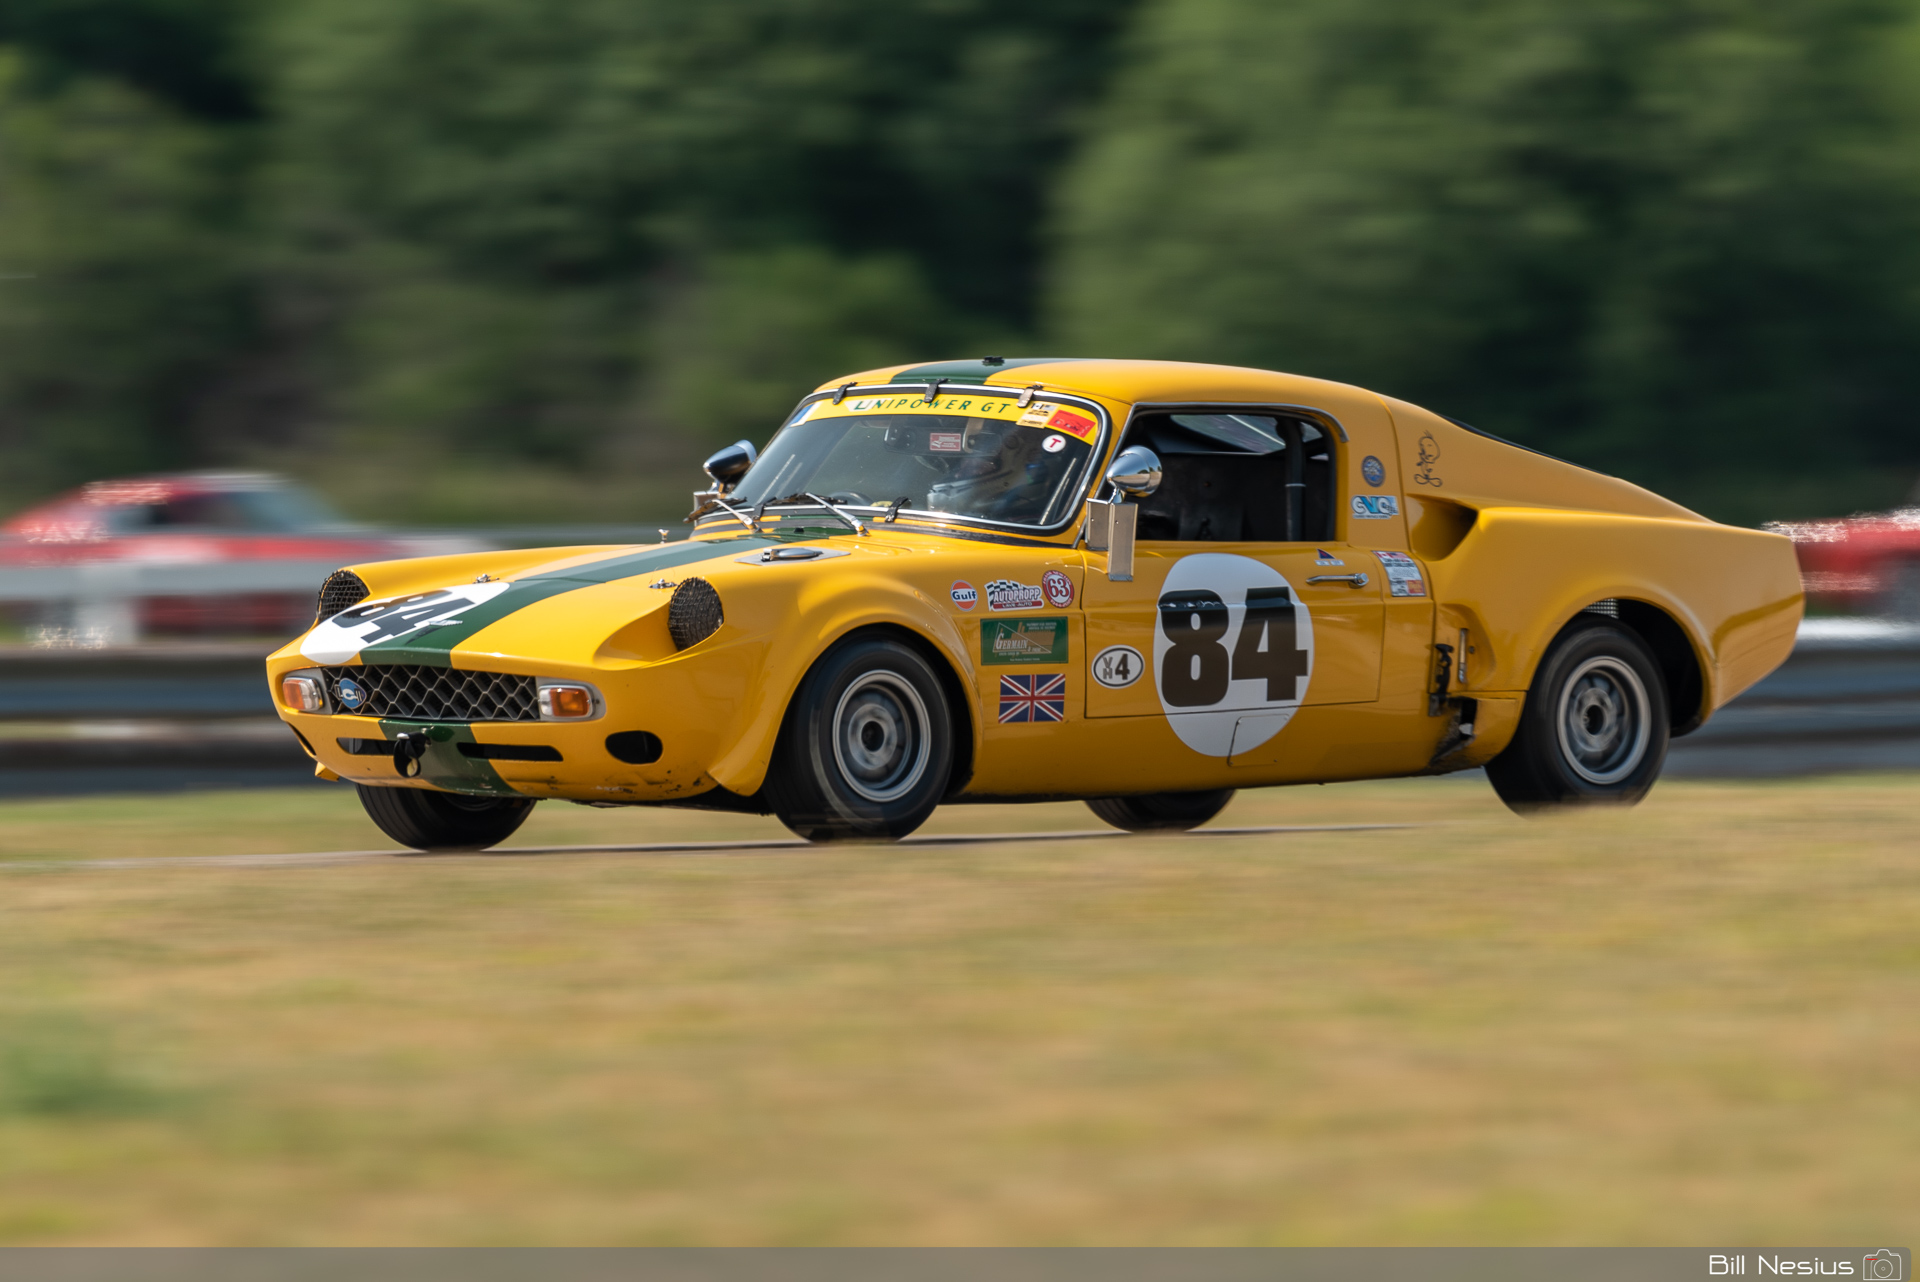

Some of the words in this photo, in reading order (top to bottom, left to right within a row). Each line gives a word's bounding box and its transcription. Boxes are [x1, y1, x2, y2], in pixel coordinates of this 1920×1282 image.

[854, 398, 972, 411] UNIPOWER
[981, 402, 1012, 414] GT
[1049, 437, 1062, 449] T
[952, 590, 977, 601] Gulf
[993, 587, 1040, 602] AUTOPROPP
[1047, 577, 1070, 598] 63
[331, 589, 476, 644] 84
[995, 632, 1029, 650] GERMAIN
[1158, 586, 1308, 708] 84
[1115, 653, 1130, 680] 4
